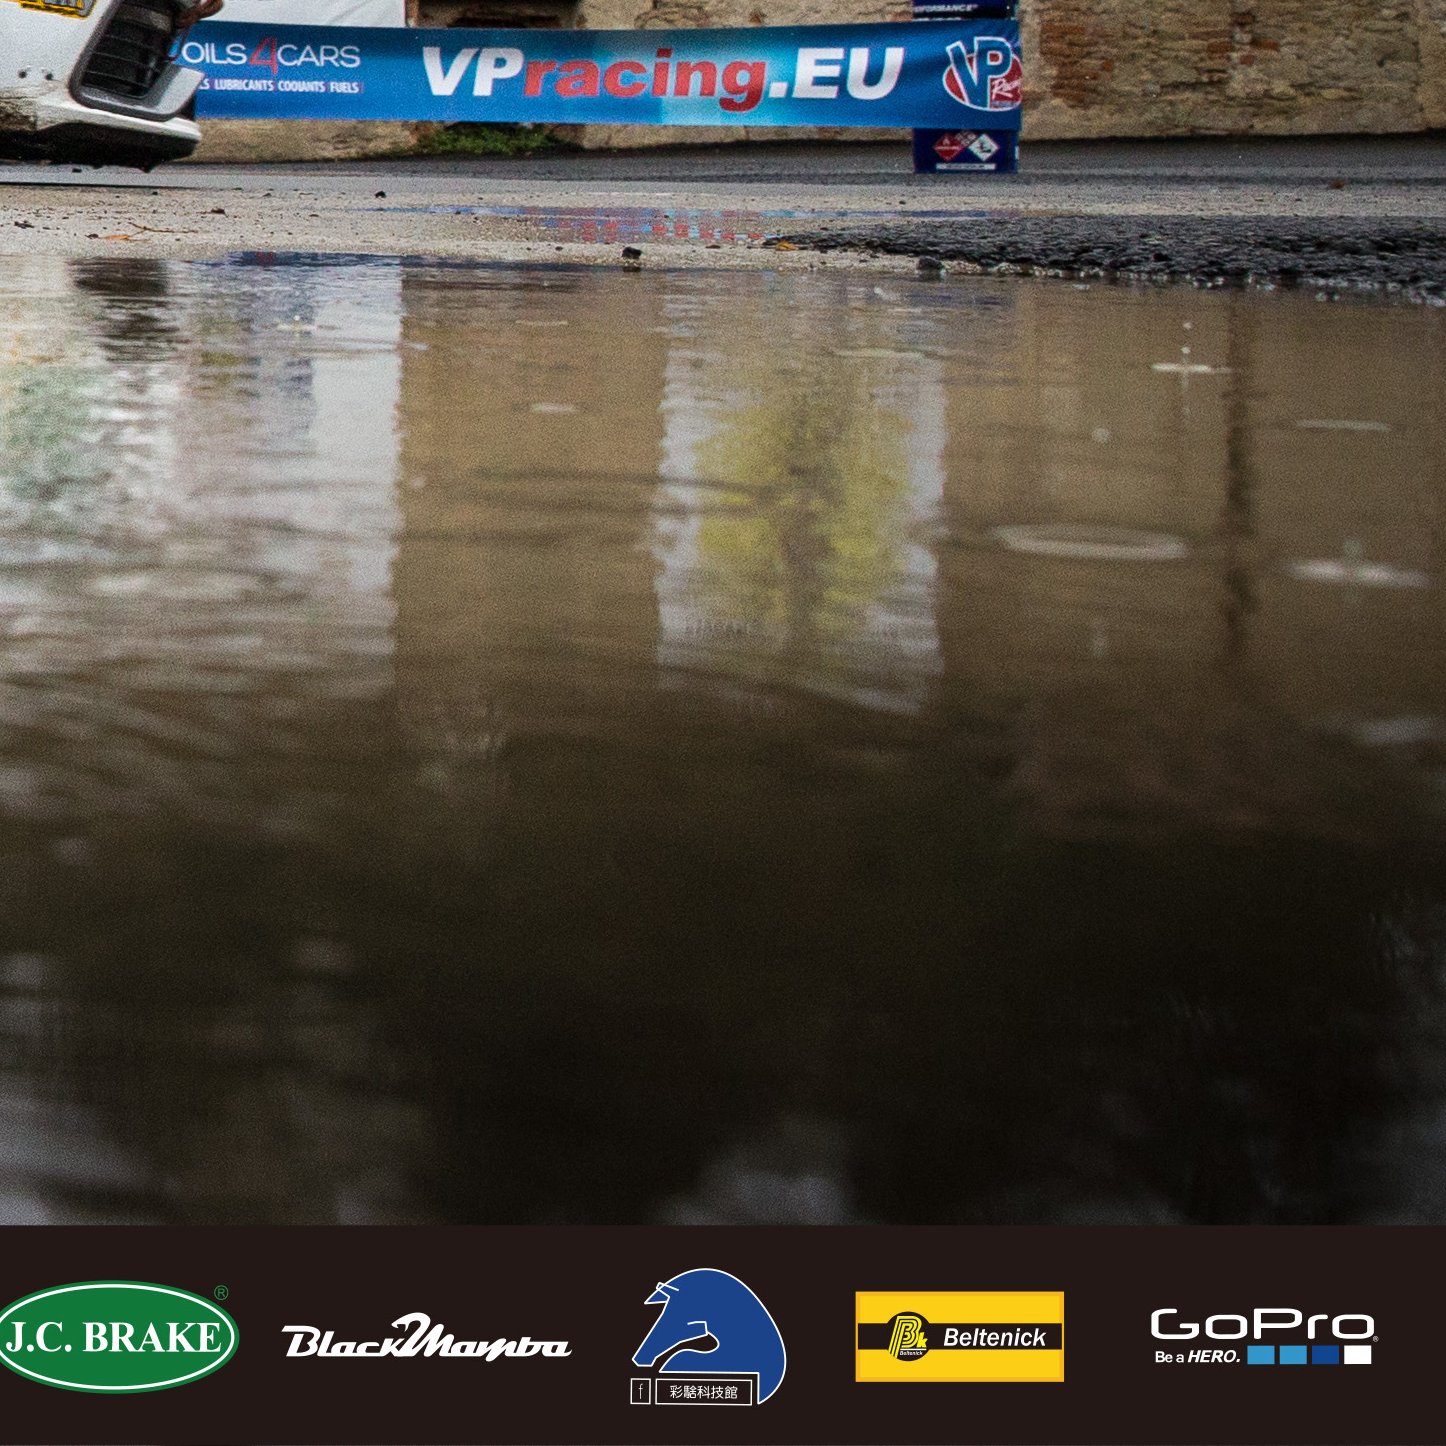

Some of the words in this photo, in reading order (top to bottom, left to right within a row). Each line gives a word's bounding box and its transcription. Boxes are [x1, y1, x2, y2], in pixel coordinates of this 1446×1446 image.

[181, 37, 360, 75] OILS4CARS
[214, 79, 274, 92] LUBRICANTS
[330, 82, 359, 94] FUELS
[421, 46, 905, 113] VPracing.EU
